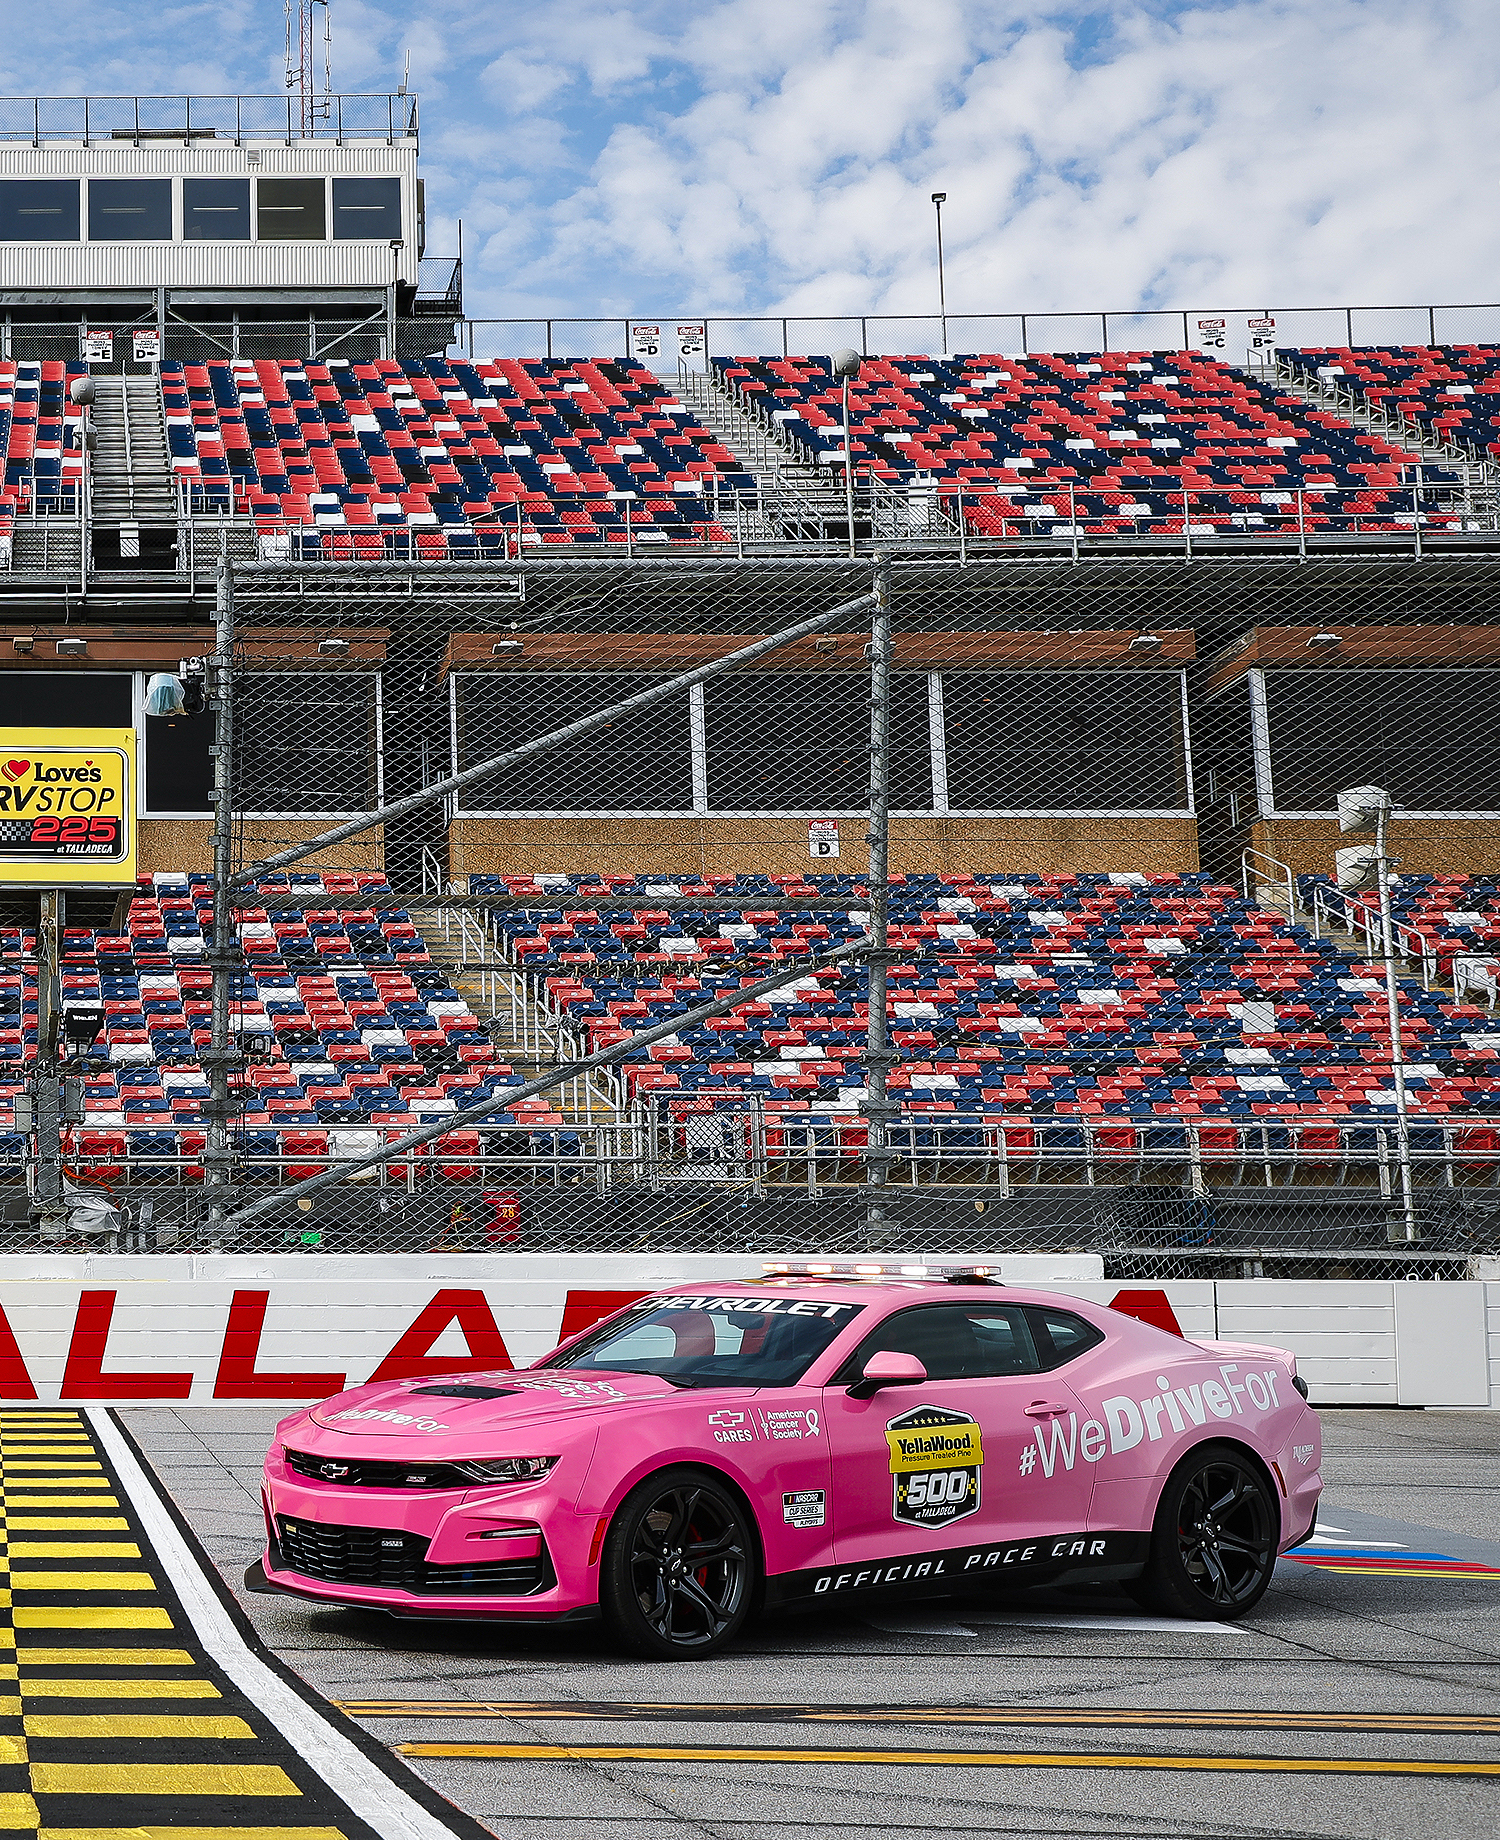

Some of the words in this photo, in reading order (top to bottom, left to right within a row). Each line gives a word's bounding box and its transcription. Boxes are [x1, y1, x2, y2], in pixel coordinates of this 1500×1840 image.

[1215, 338, 1226, 348] C
[1252, 338, 1264, 347] B
[101, 349, 111, 359] E
[136, 349, 146, 359] D
[647, 346, 658, 355] D
[681, 345, 692, 355] C
[30, 815, 119, 843] 225
[56, 846, 65, 854] at
[65, 844, 113, 854] TALLADEGA
[818, 841, 831, 855] D
[501, 1207, 515, 1218] 28
[766, 1409, 806, 1420] American
[768, 1419, 799, 1429] Cancer
[1017, 1363, 1278, 1479] #WeDriveFor
[713, 1430, 753, 1442] CARES
[772, 1429, 802, 1440] Society
[901, 1454, 931, 1463] Pressure
[932, 1451, 957, 1460] Treated
[957, 1450, 972, 1458] Pine
[906, 1470, 970, 1508] 500
[795, 1493, 819, 1503] NASCAR
[789, 1507, 800, 1516] CUP
[800, 1505, 819, 1515] SERIES
[921, 1506, 956, 1518] TALLADEGA
[814, 1559, 946, 1593] OFFICIAL
[964, 1546, 1037, 1570] PACE
[1051, 1540, 1106, 1557] CAR
